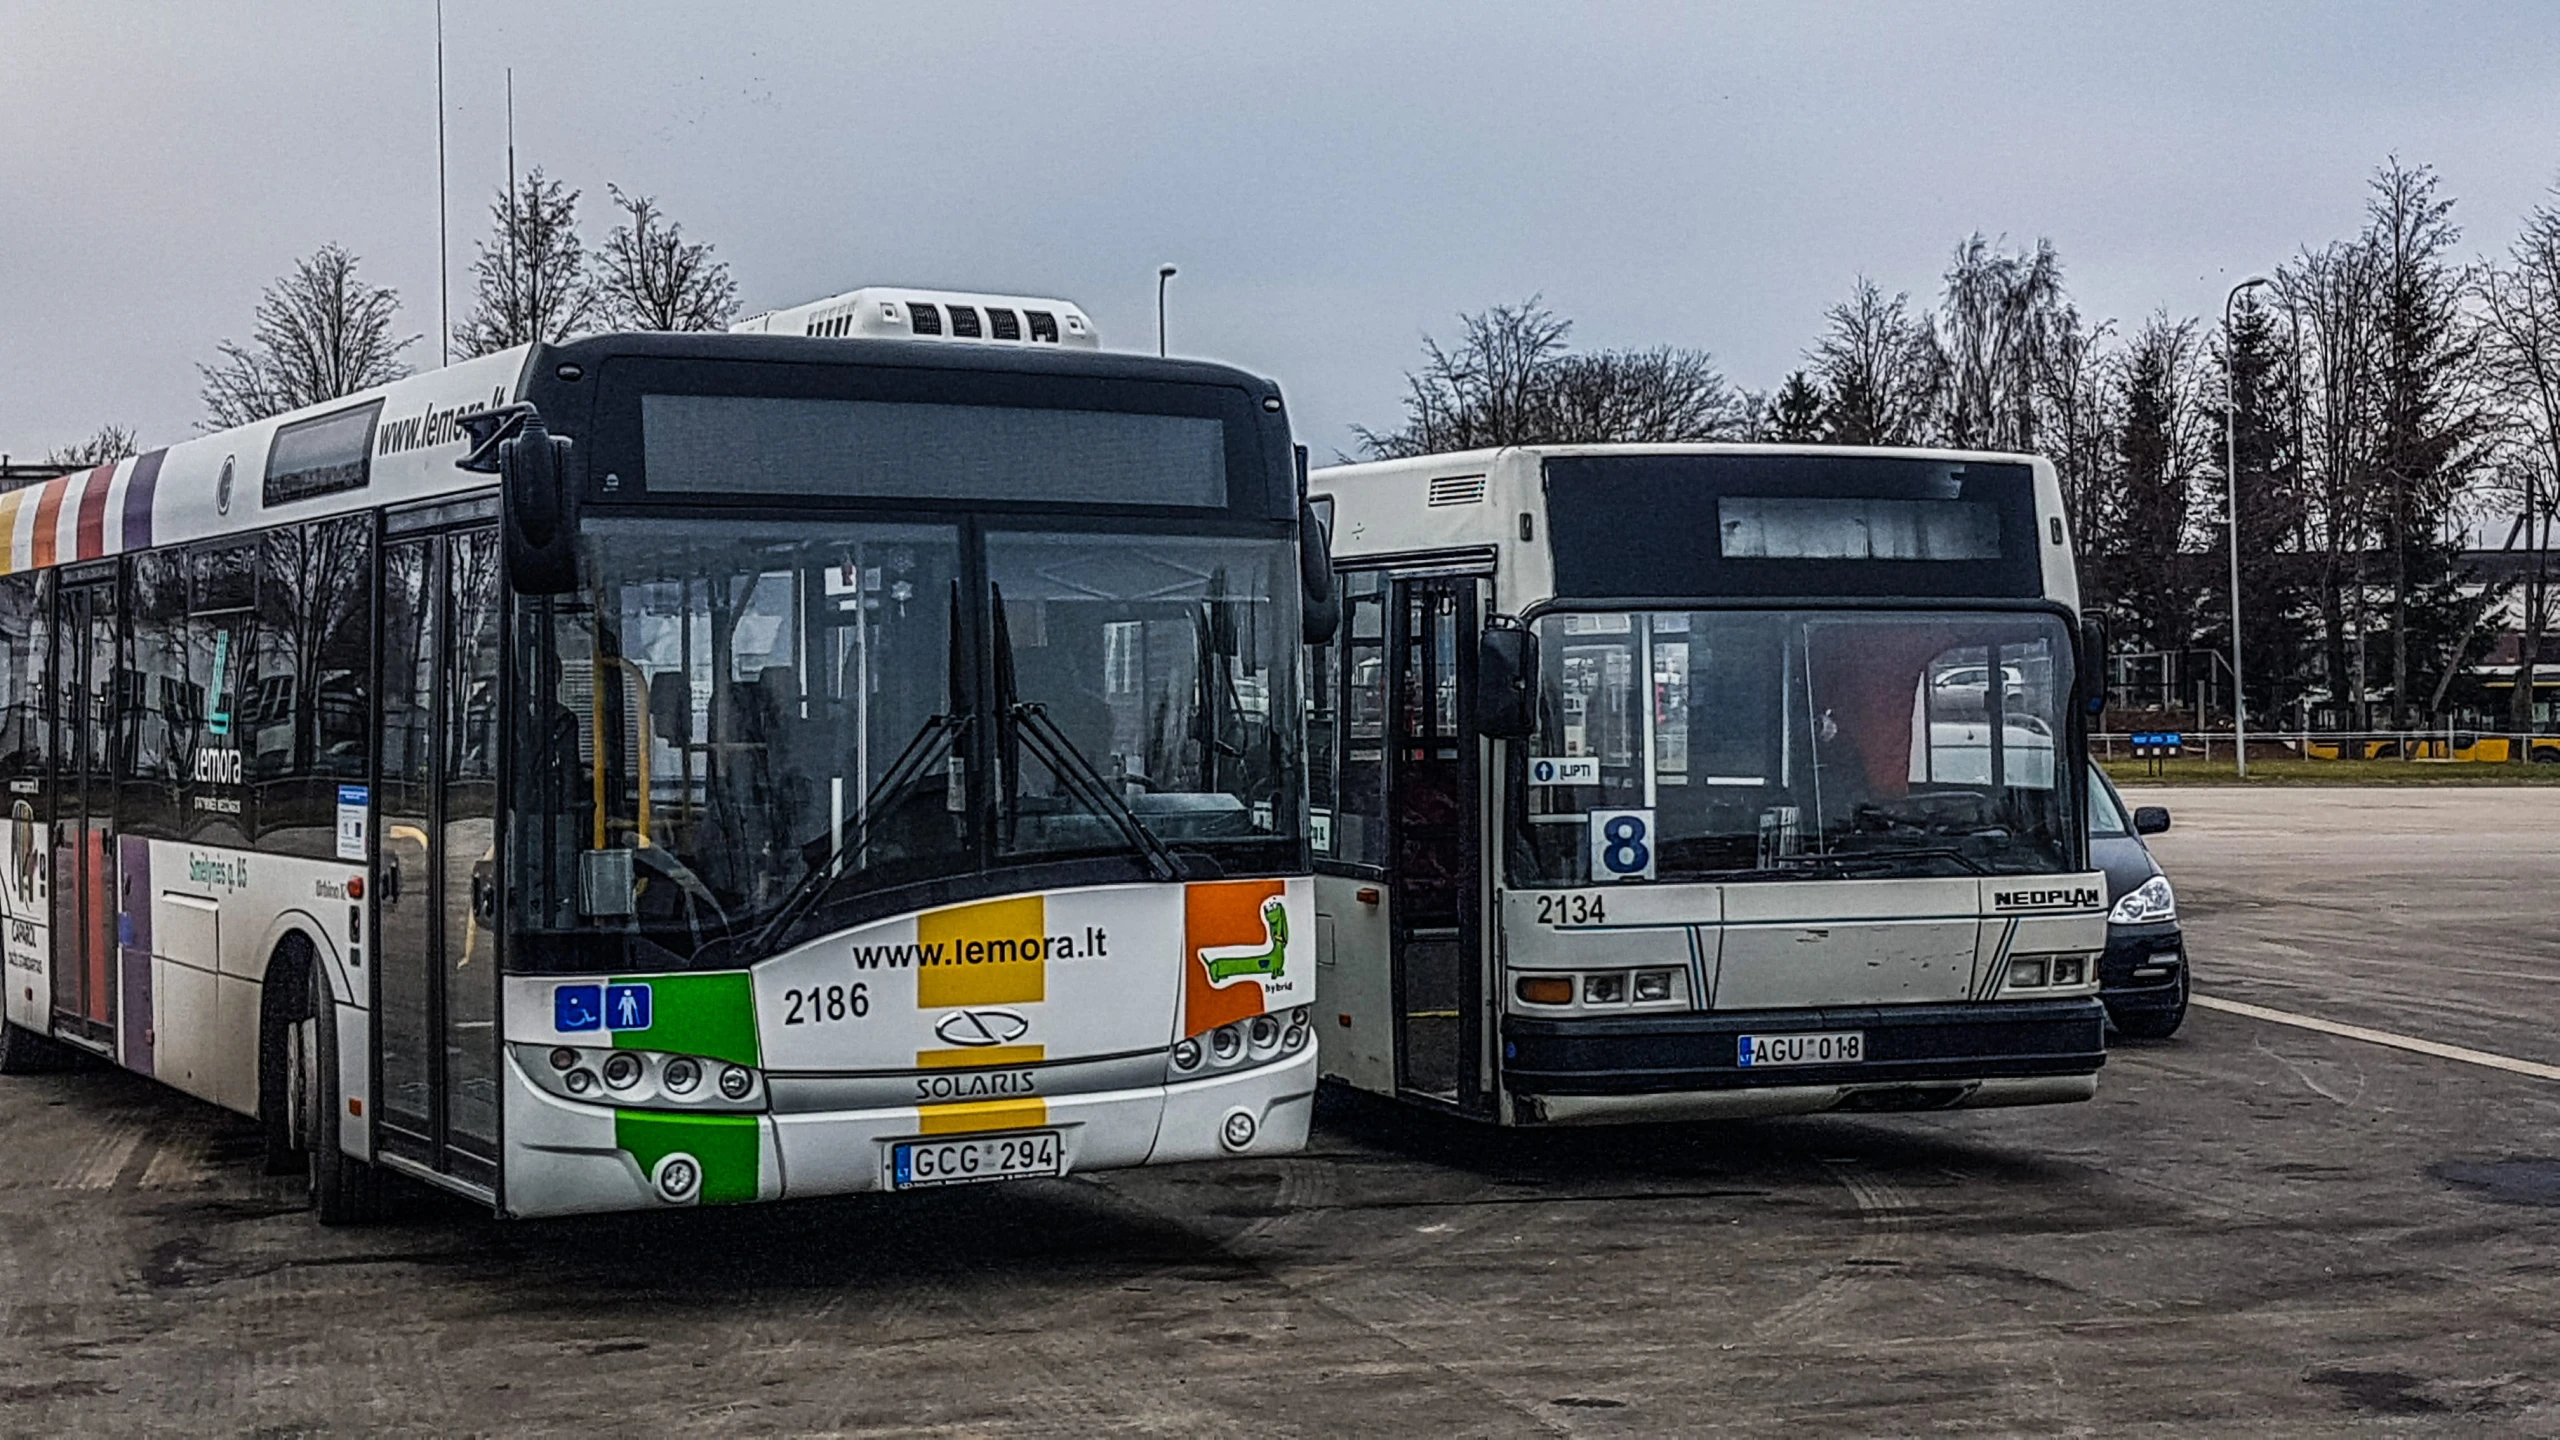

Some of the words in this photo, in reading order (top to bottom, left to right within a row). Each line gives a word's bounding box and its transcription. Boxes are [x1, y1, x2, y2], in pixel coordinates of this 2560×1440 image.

[379, 386, 506, 456] www.lemorlt
[1603, 815, 1649, 874] 8
[1537, 894, 1606, 924] 2134
[1994, 888, 2099, 908] NEOPLAN
[853, 927, 1107, 970] www.lemora.lt
[1265, 981, 1293, 995] hybrid
[785, 982, 869, 1026] 2186
[1755, 1038, 1804, 1063] AGU
[1819, 1036, 1859, 1060] 018
[916, 1072, 1035, 1100] SOLARIS
[915, 1144, 979, 1177] GCG
[1000, 1138, 1053, 1170] 294
[897, 1168, 910, 1178] LT
